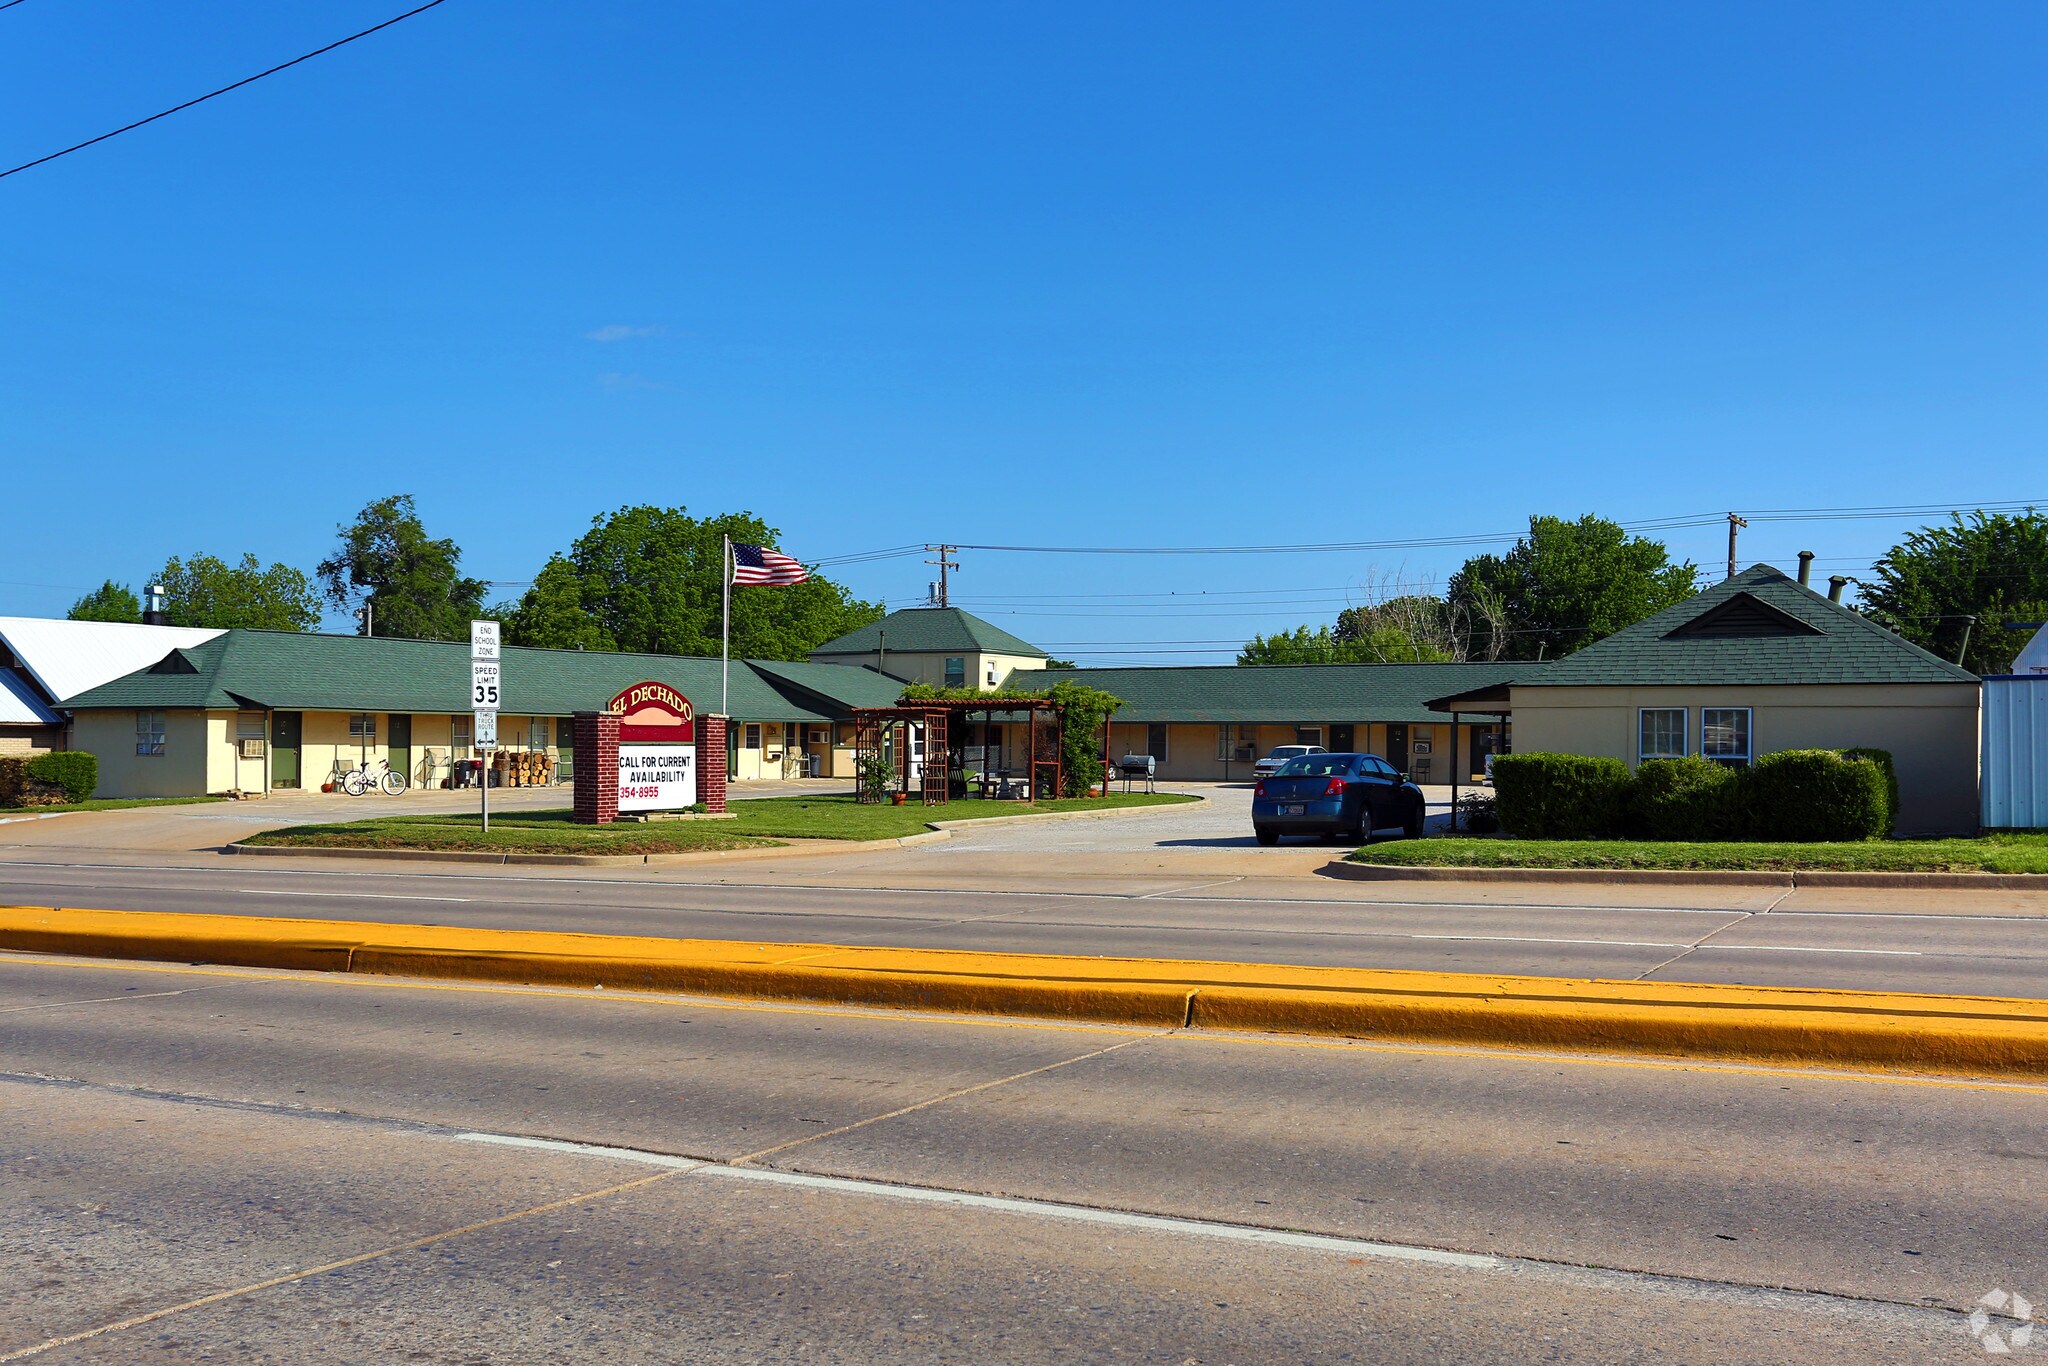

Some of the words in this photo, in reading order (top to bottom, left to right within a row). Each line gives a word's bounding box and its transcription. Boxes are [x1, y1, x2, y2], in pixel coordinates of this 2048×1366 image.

[480, 627, 491, 635] END
[475, 637, 496, 646] SCHOOL
[478, 648, 493, 656] ZONE
[475, 667, 497, 675] SPEED
[475, 686, 497, 703] 35
[612, 696, 628, 713] EL
[630, 685, 692, 721] DECHADO
[619, 756, 640, 768] CALL
[641, 756, 657, 768] FOR
[658, 756, 691, 768] CURRENT
[629, 771, 685, 783] AVAILABILITY
[619, 786, 659, 798] 354-8955
